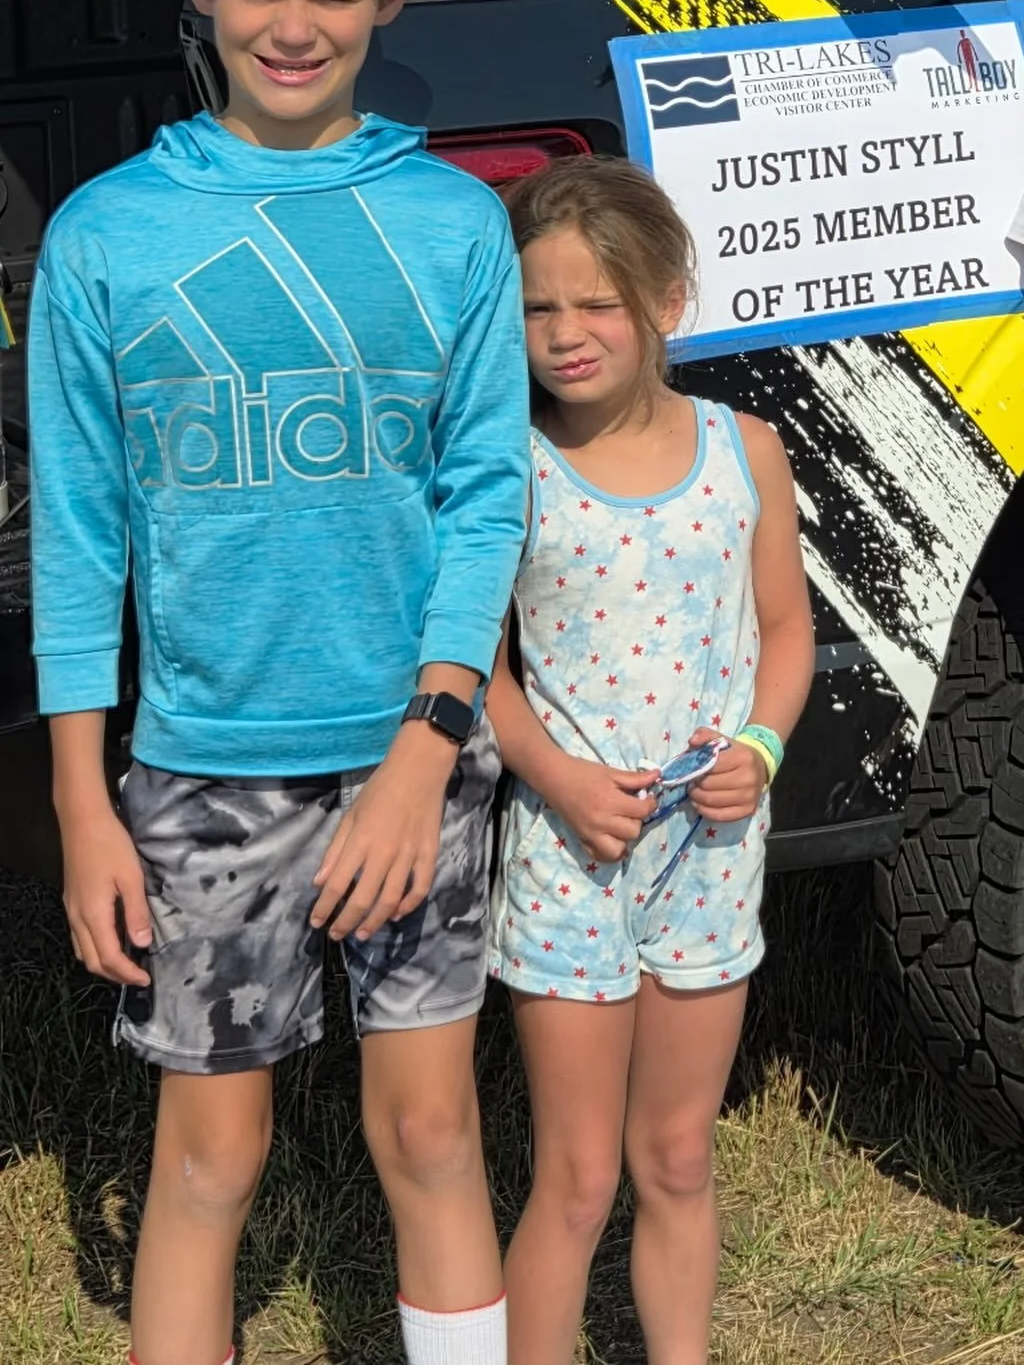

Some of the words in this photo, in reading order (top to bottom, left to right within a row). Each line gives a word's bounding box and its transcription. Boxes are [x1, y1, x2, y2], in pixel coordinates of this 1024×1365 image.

[734, 39, 892, 77] TRI-LAKES
[743, 91, 810, 108] ECONOMIC
[812, 82, 898, 101] DEVELOPMENT
[744, 81, 805, 95] CHAMBER
[807, 77, 821, 89] OF
[824, 69, 893, 86] COMMERCE
[922, 64, 971, 98] TALL
[978, 58, 1017, 92] BOY
[775, 102, 823, 117] VISITOR
[825, 97, 872, 112] CENTER
[931, 92, 1020, 110] MARKETING
[711, 144, 848, 193] JUSTIN
[861, 130, 976, 174] STYLL
[717, 217, 801, 258] 2025
[813, 193, 981, 245] MEMBER
[731, 284, 784, 322] OF
[795, 272, 875, 313] THE
[884, 257, 990, 300] YEAR
